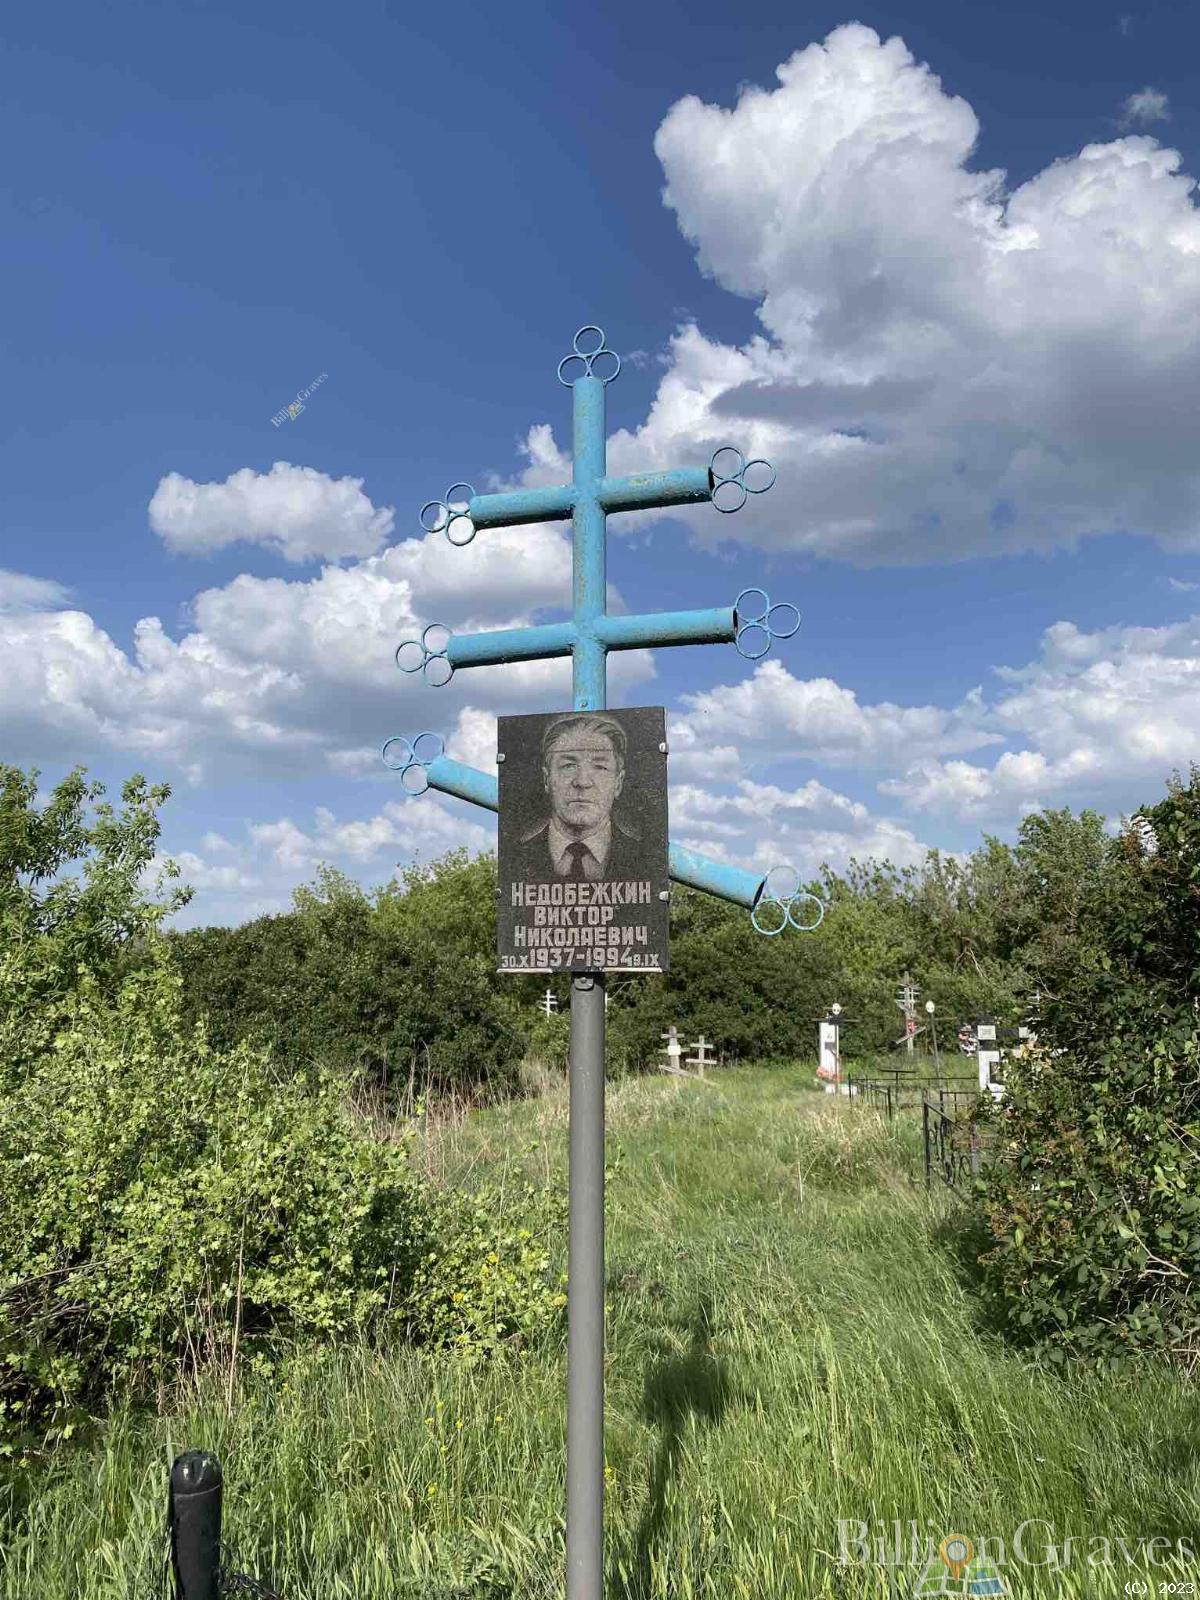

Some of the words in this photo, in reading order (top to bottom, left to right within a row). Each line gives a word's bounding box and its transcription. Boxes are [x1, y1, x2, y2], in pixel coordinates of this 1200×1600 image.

[511, 881, 651, 906] НЕДОБЕЖКИН
[534, 906, 614, 926] ВИКТОР
[514, 925, 648, 947] НИКОЛАЕВИЧ
